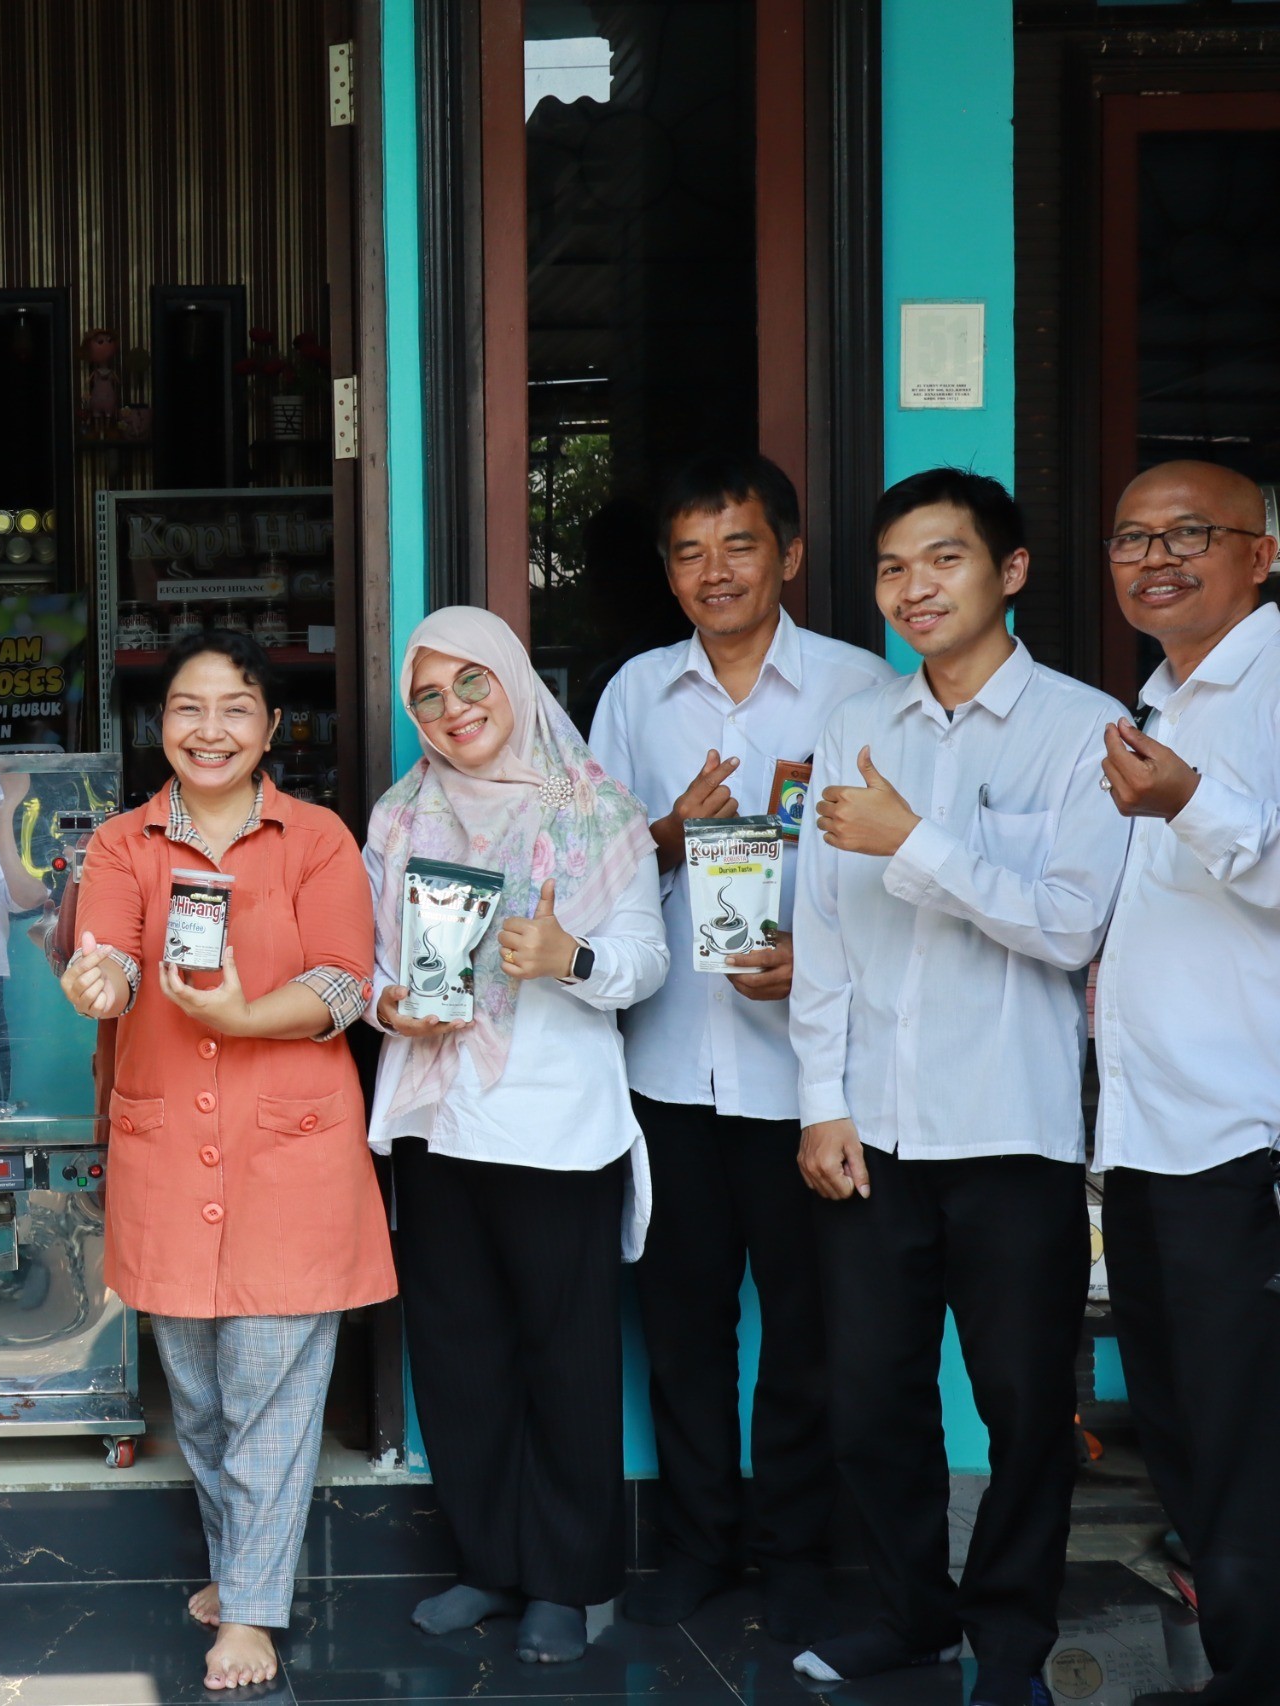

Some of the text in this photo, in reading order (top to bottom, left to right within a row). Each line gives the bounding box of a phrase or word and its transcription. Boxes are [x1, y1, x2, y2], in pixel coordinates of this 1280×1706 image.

[128, 512, 243, 570] Kopi
[159, 585, 199, 594] EFGEEN
[201, 584, 225, 593] KOPI
[11, 702, 62, 718] BUBUK
[690, 839, 779, 862] Kopi Hirang
[177, 896, 221, 925] Hirang
[181, 921, 204, 932] Coffee
